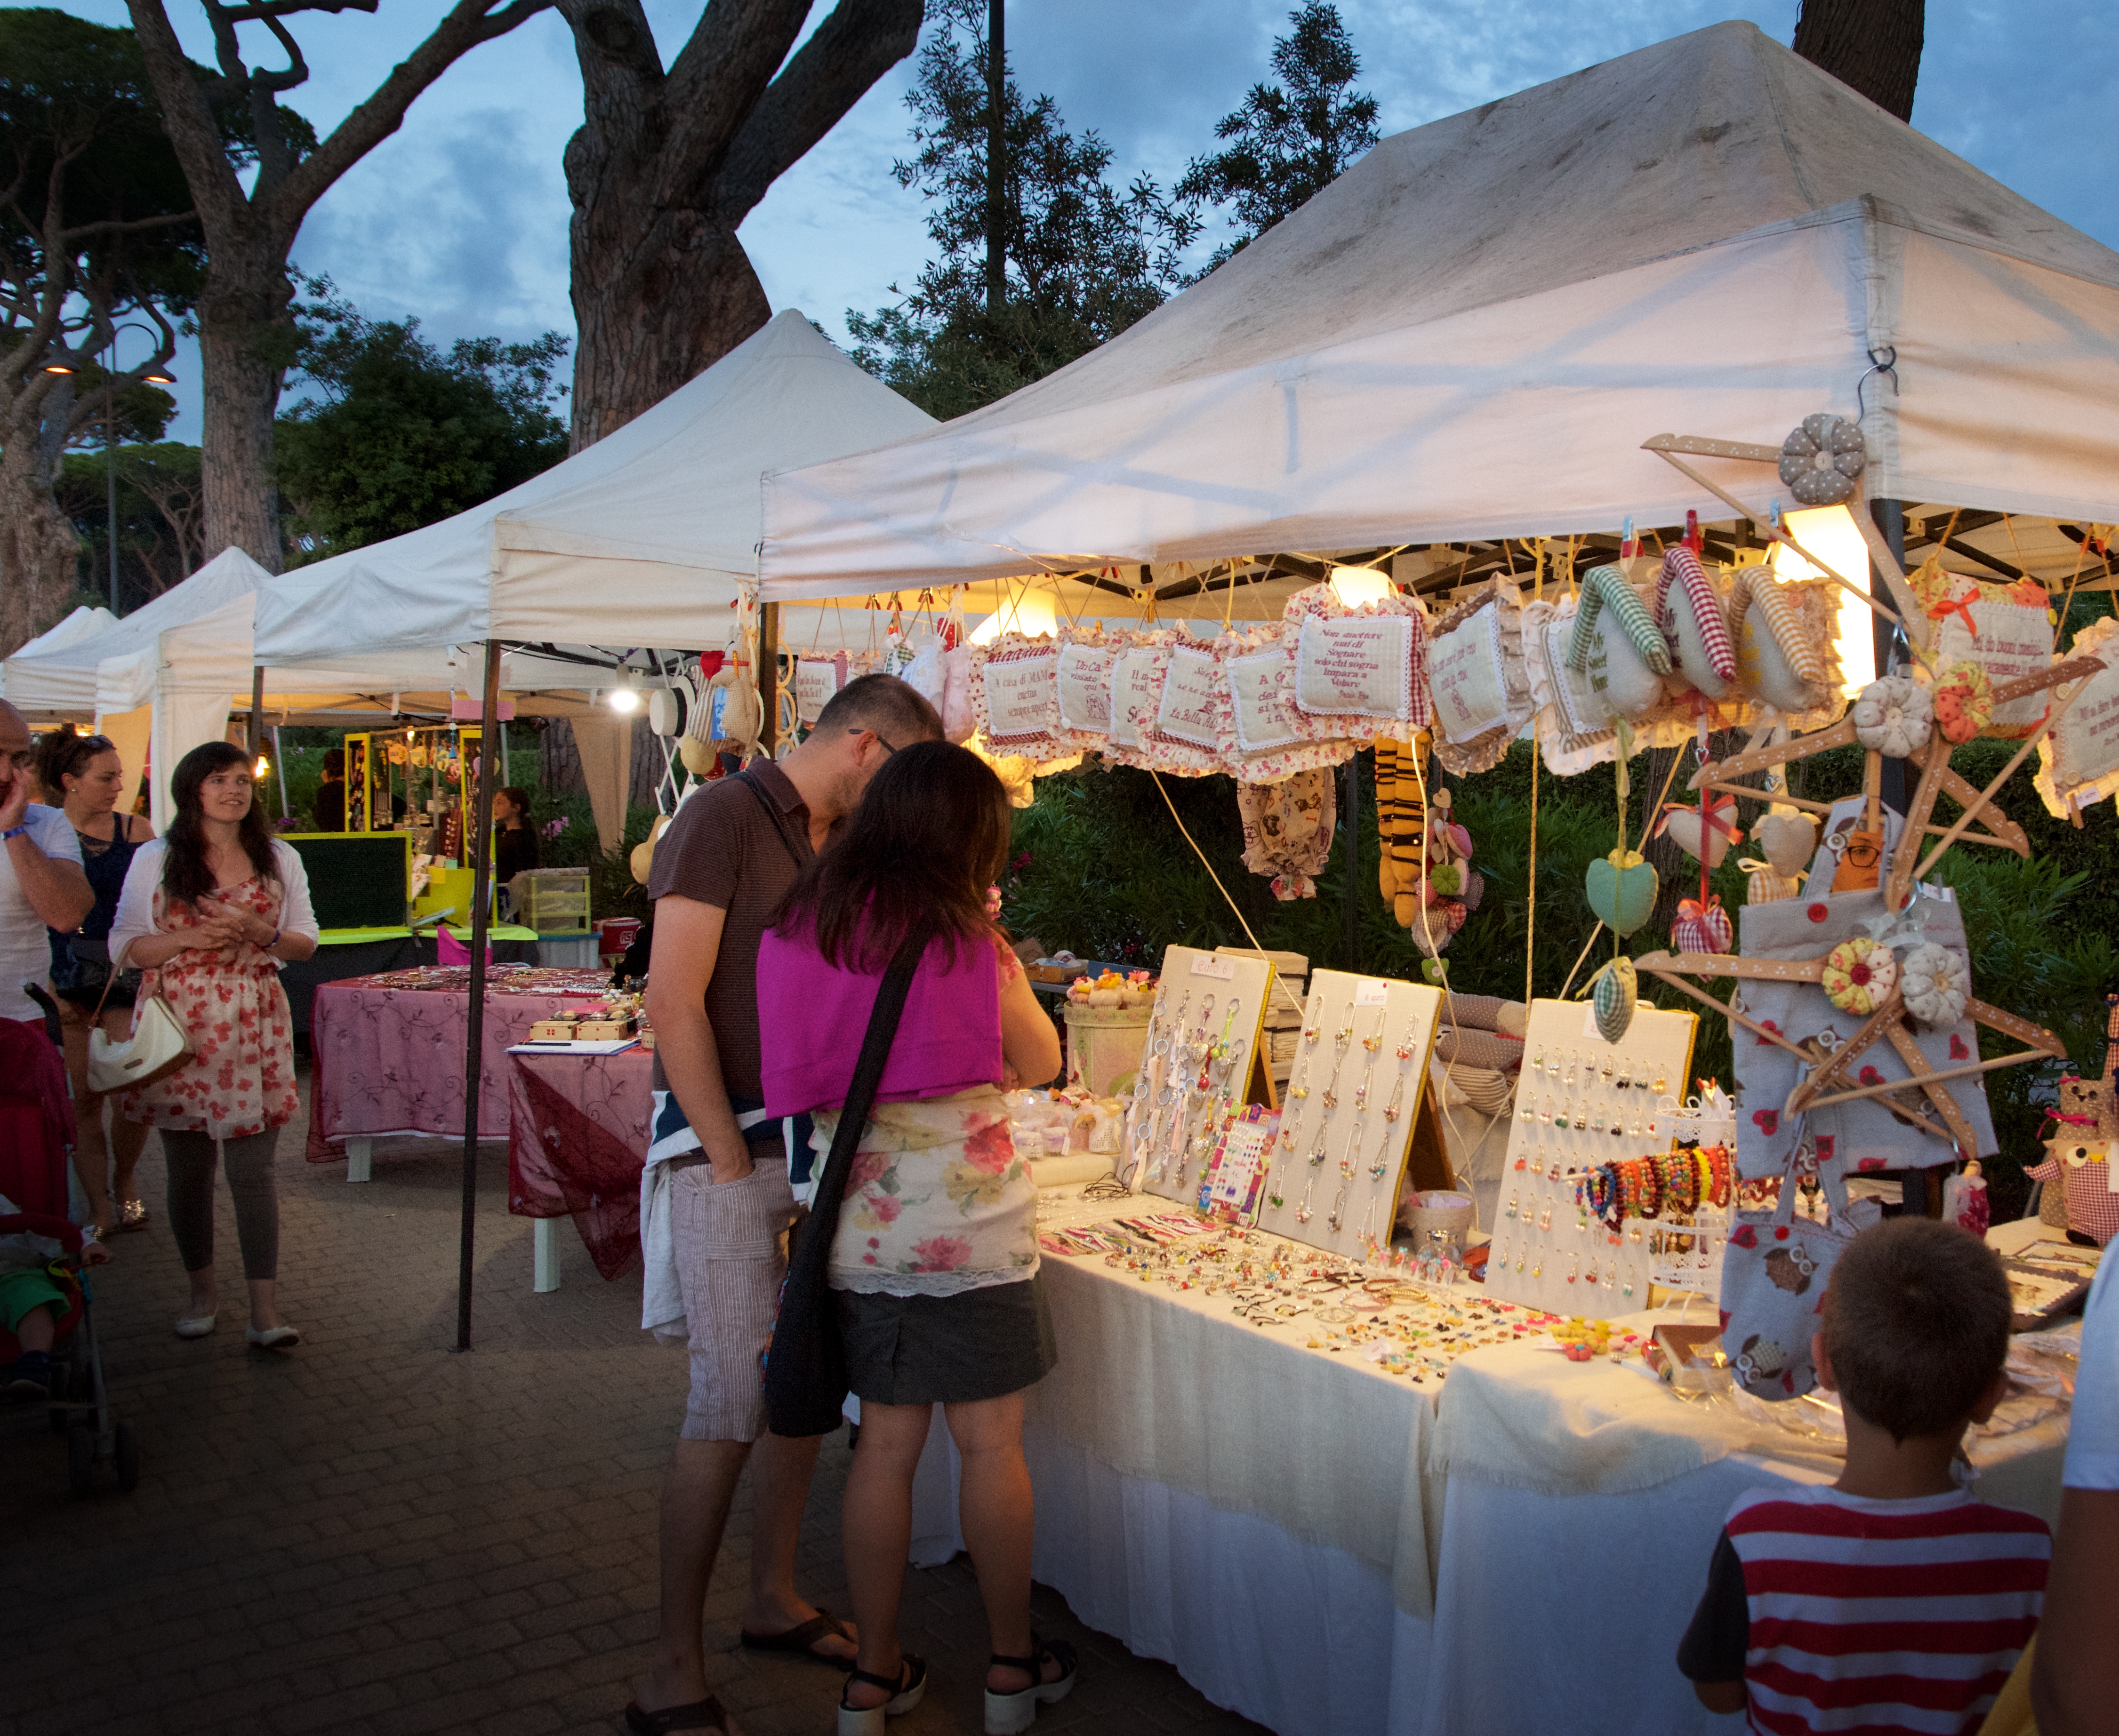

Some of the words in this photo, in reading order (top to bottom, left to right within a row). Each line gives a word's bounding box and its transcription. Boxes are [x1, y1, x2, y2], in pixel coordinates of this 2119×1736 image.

[1352, 640, 1364, 648] di
[1326, 648, 1366, 658] Sognare
[1332, 659, 1348, 667] chi
[1348, 661, 1379, 670] sogna
[1071, 673, 1098, 682] viziato
[1323, 667, 1358, 678] impara
[1003, 679, 1017, 687] casa
[1259, 674, 1268, 685] A
[1331, 678, 1360, 688] Volare
[1018, 688, 1037, 700] cucina
[1008, 705, 1030, 718] sempre
[1180, 709, 1202, 725] Bella
